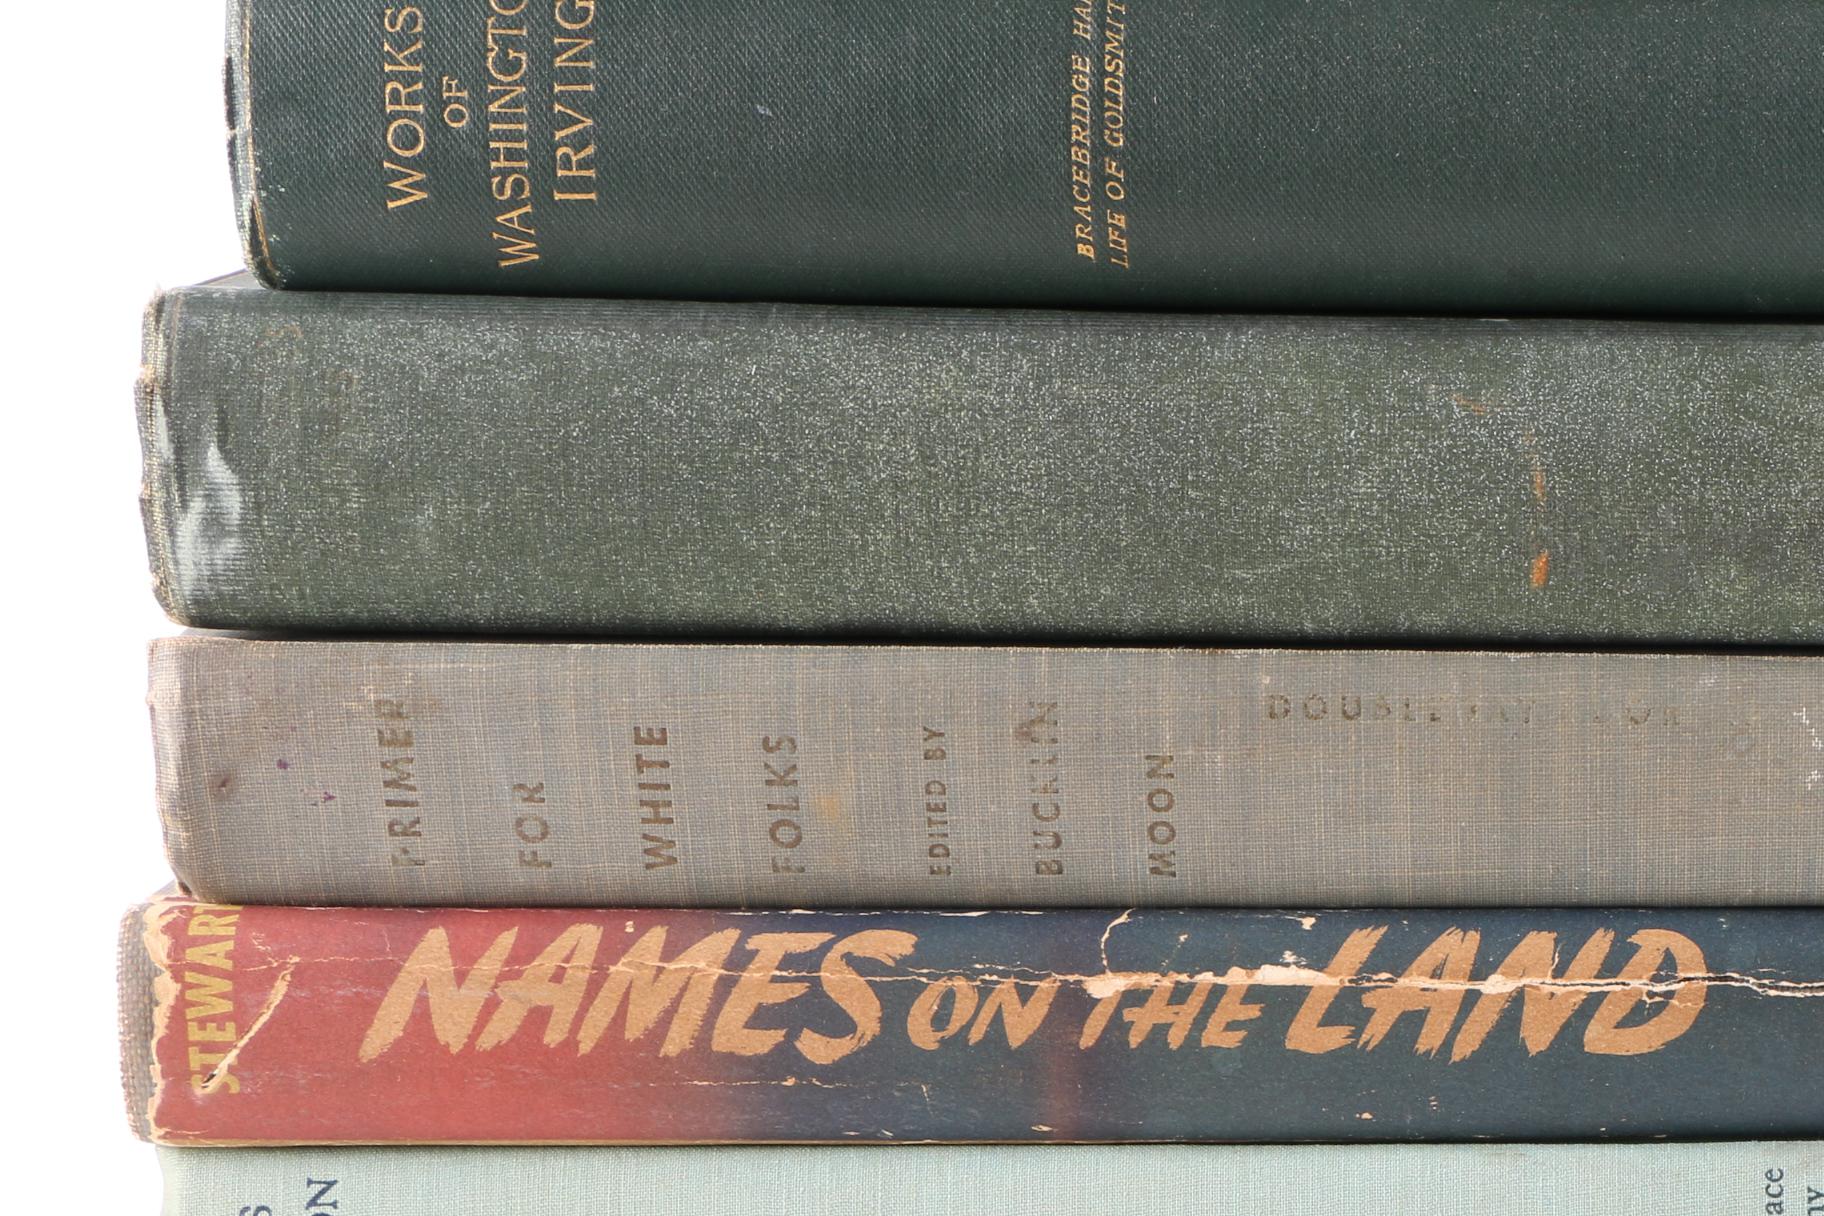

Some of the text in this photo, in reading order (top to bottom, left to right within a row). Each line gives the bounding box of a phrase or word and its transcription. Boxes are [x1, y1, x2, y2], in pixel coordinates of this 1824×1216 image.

[383, 5, 428, 210] WORKS
[442, 76, 469, 128] OF
[553, 0, 597, 201] IRVING
[1072, 54, 1096, 264] BRACEBRIDGE
[1104, 157, 1126, 201] OF
[1107, 208, 1129, 270] LIFE
[512, 779, 553, 869] FOR
[633, 724, 679, 871] WHITE
[761, 732, 806, 875] FOLKS
[922, 726, 952, 878] EDITED BY
[1144, 753, 1178, 879] MOON
[357, 924, 1708, 1065] NAMES ON THE LAND
